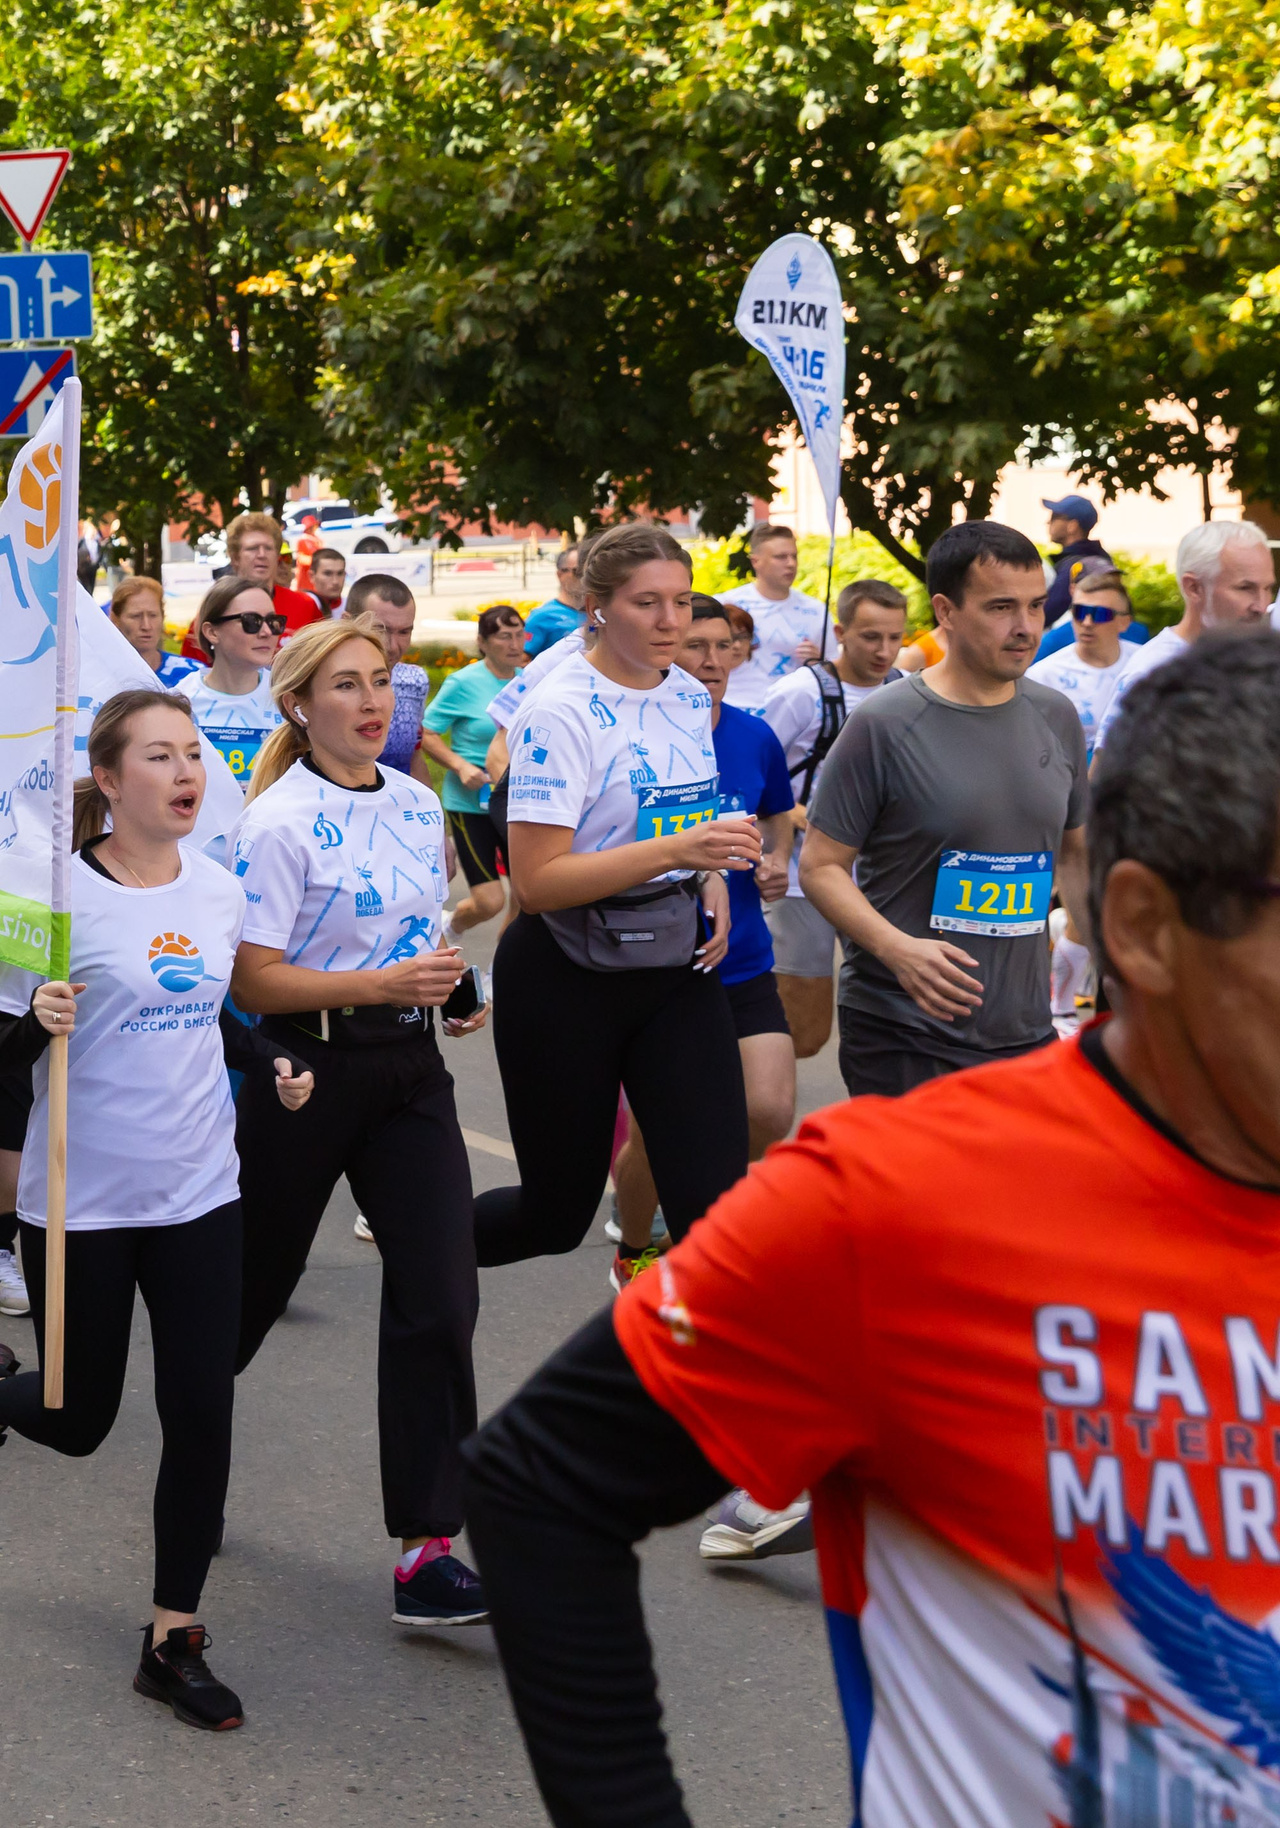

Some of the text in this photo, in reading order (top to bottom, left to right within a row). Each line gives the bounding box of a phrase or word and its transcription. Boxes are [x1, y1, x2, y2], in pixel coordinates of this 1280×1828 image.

[782, 346, 825, 380] 4:16
[662, 782, 711, 798] ДИНАМОВСКАЯ
[967, 853, 1034, 864] ДИНАМОВСКАЯ
[989, 864, 1017, 872] МИЛЯ
[955, 879, 1033, 915] 1211
[139, 1001, 216, 1018] ОТКРЫВАЕМ
[120, 1017, 180, 1033] РОССИЮ
[1042, 1406, 1280, 1466] INTER
[1046, 1451, 1280, 1563] MAR
